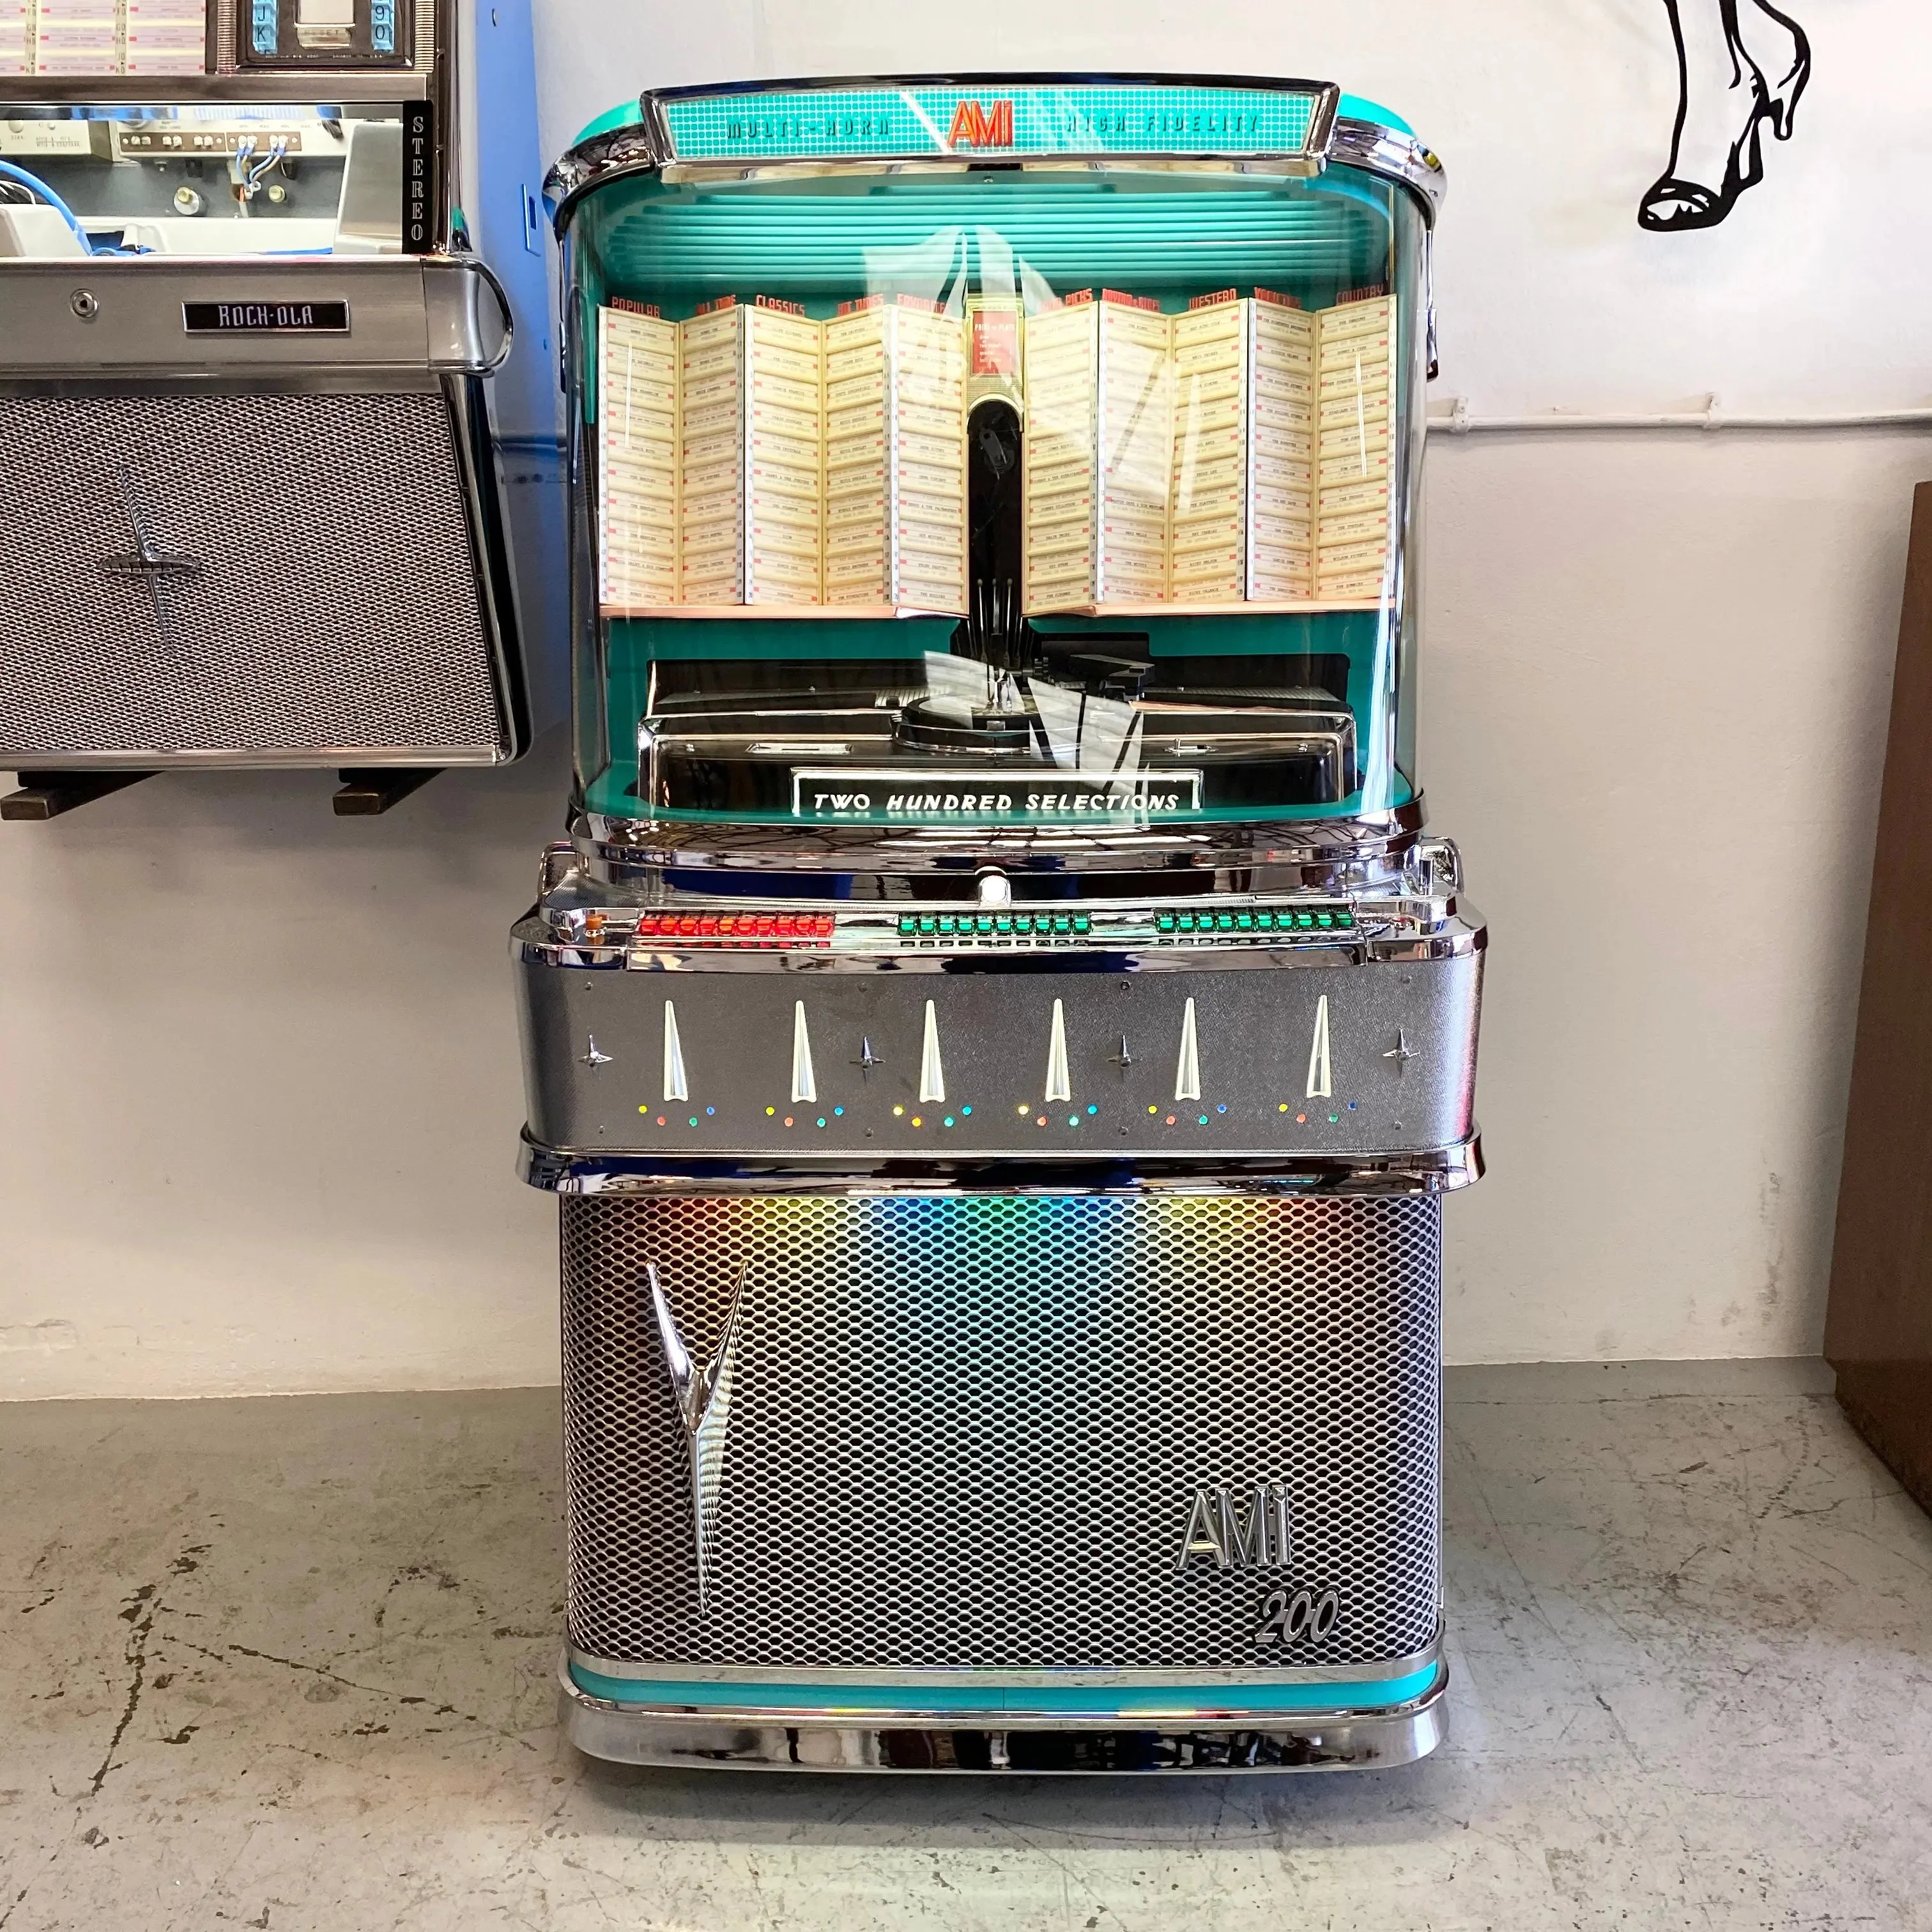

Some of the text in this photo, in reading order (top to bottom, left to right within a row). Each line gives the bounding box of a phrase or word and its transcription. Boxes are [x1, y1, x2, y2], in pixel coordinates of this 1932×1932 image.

[257, 6, 266, 22] J
[375, 5, 385, 20] 9
[257, 27, 266, 42] K
[728, 118, 889, 139] MULTI-HORN
[948, 100, 1013, 147] AMI
[1066, 114, 1259, 133] HIGH FIDELITY
[412, 115, 424, 241] STEREO
[756, 294, 806, 318] CLASSICS
[1189, 288, 1237, 311] WESTERN
[1336, 283, 1384, 306] COUNTRY
[218, 305, 314, 327] ROCK-OLA
[611, 296, 660, 319] POPULAR
[815, 793, 1179, 811] TWO HUNDRED SELECTIONS
[1176, 1484, 1291, 1570] AMI
[1252, 1588, 1340, 1644] 200
